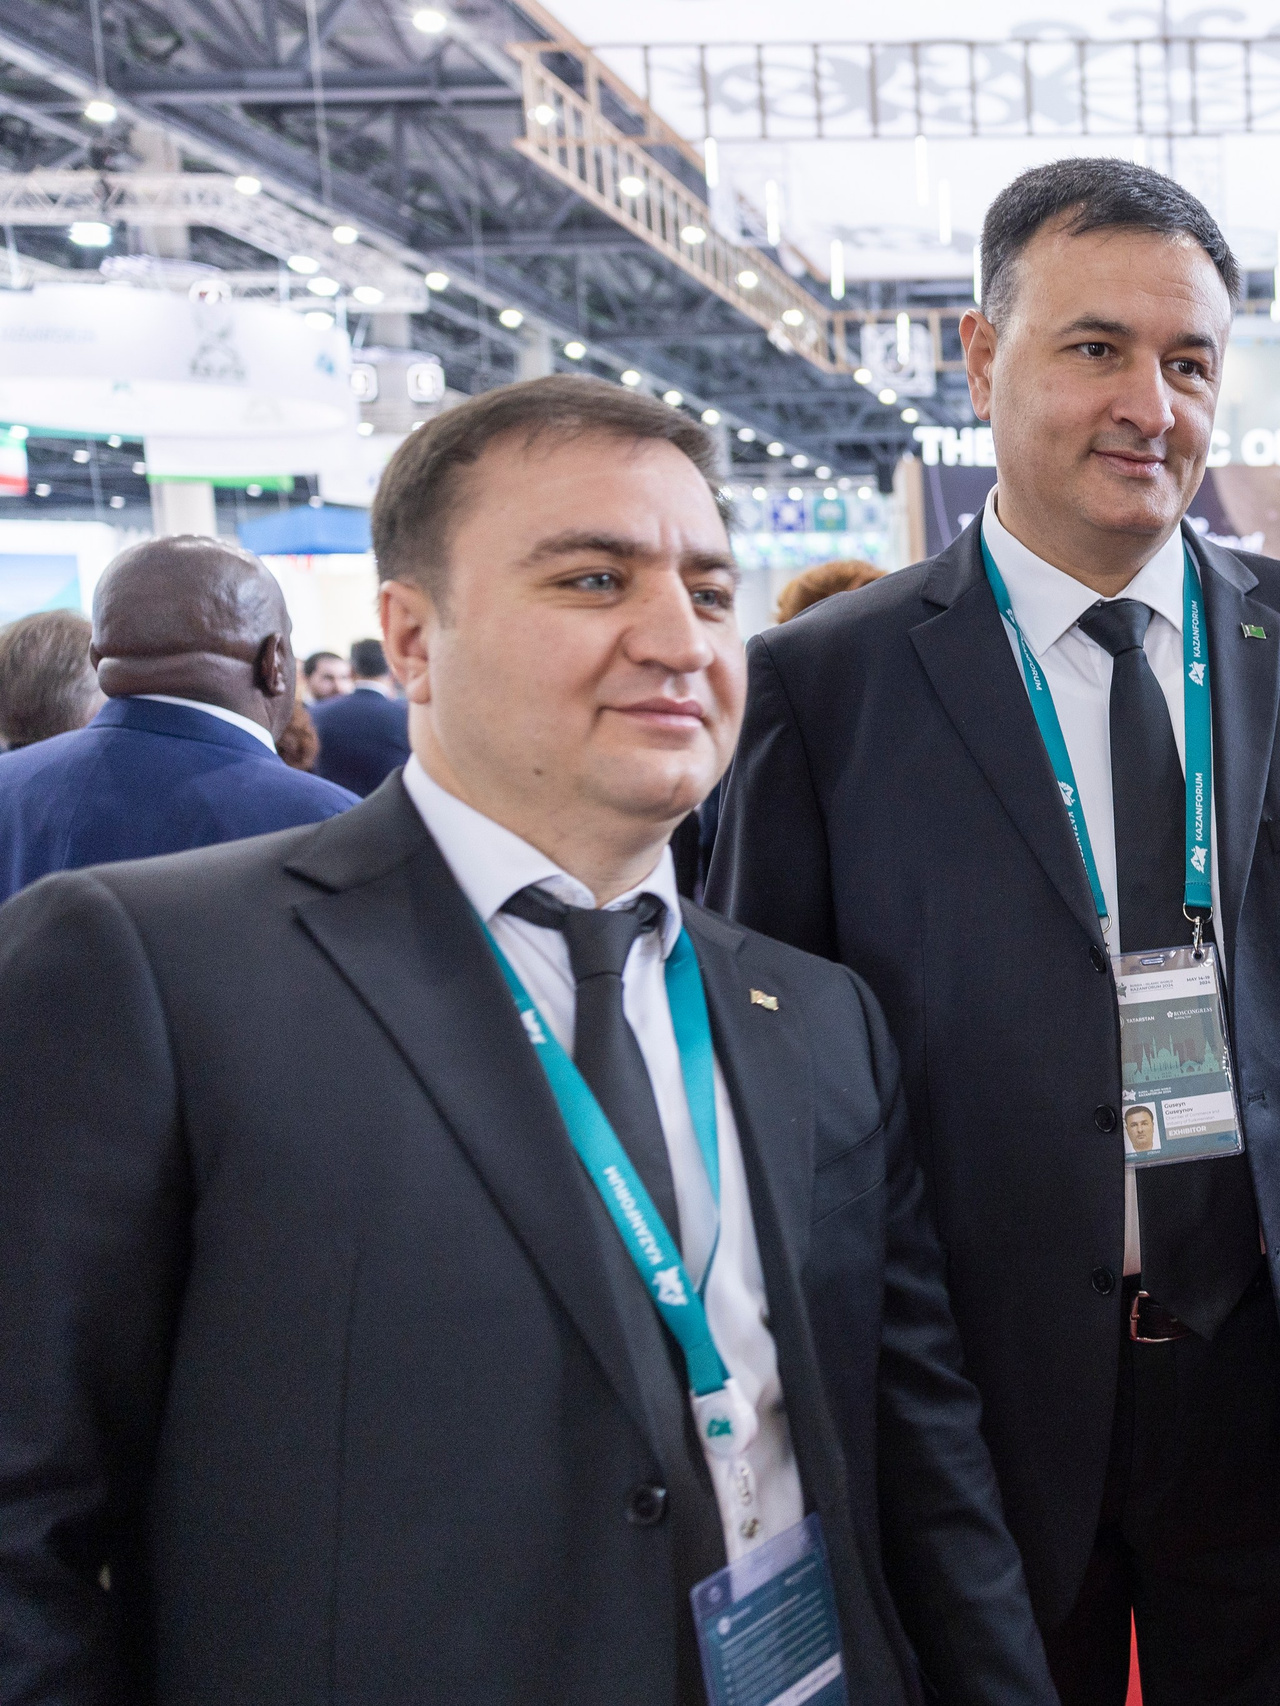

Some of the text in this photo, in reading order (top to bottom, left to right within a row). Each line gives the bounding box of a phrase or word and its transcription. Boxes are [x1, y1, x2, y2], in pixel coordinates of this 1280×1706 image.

[913, 425, 997, 467] THE
[1191, 600, 1200, 658] KAZANFORUM
[1194, 772, 1203, 841] KAZANFORUM
[1174, 1007, 1212, 1016] ROSCONGRESS
[1169, 1126, 1207, 1136] EXHIBITOR
[603, 1165, 664, 1265] KAZANFORUM
